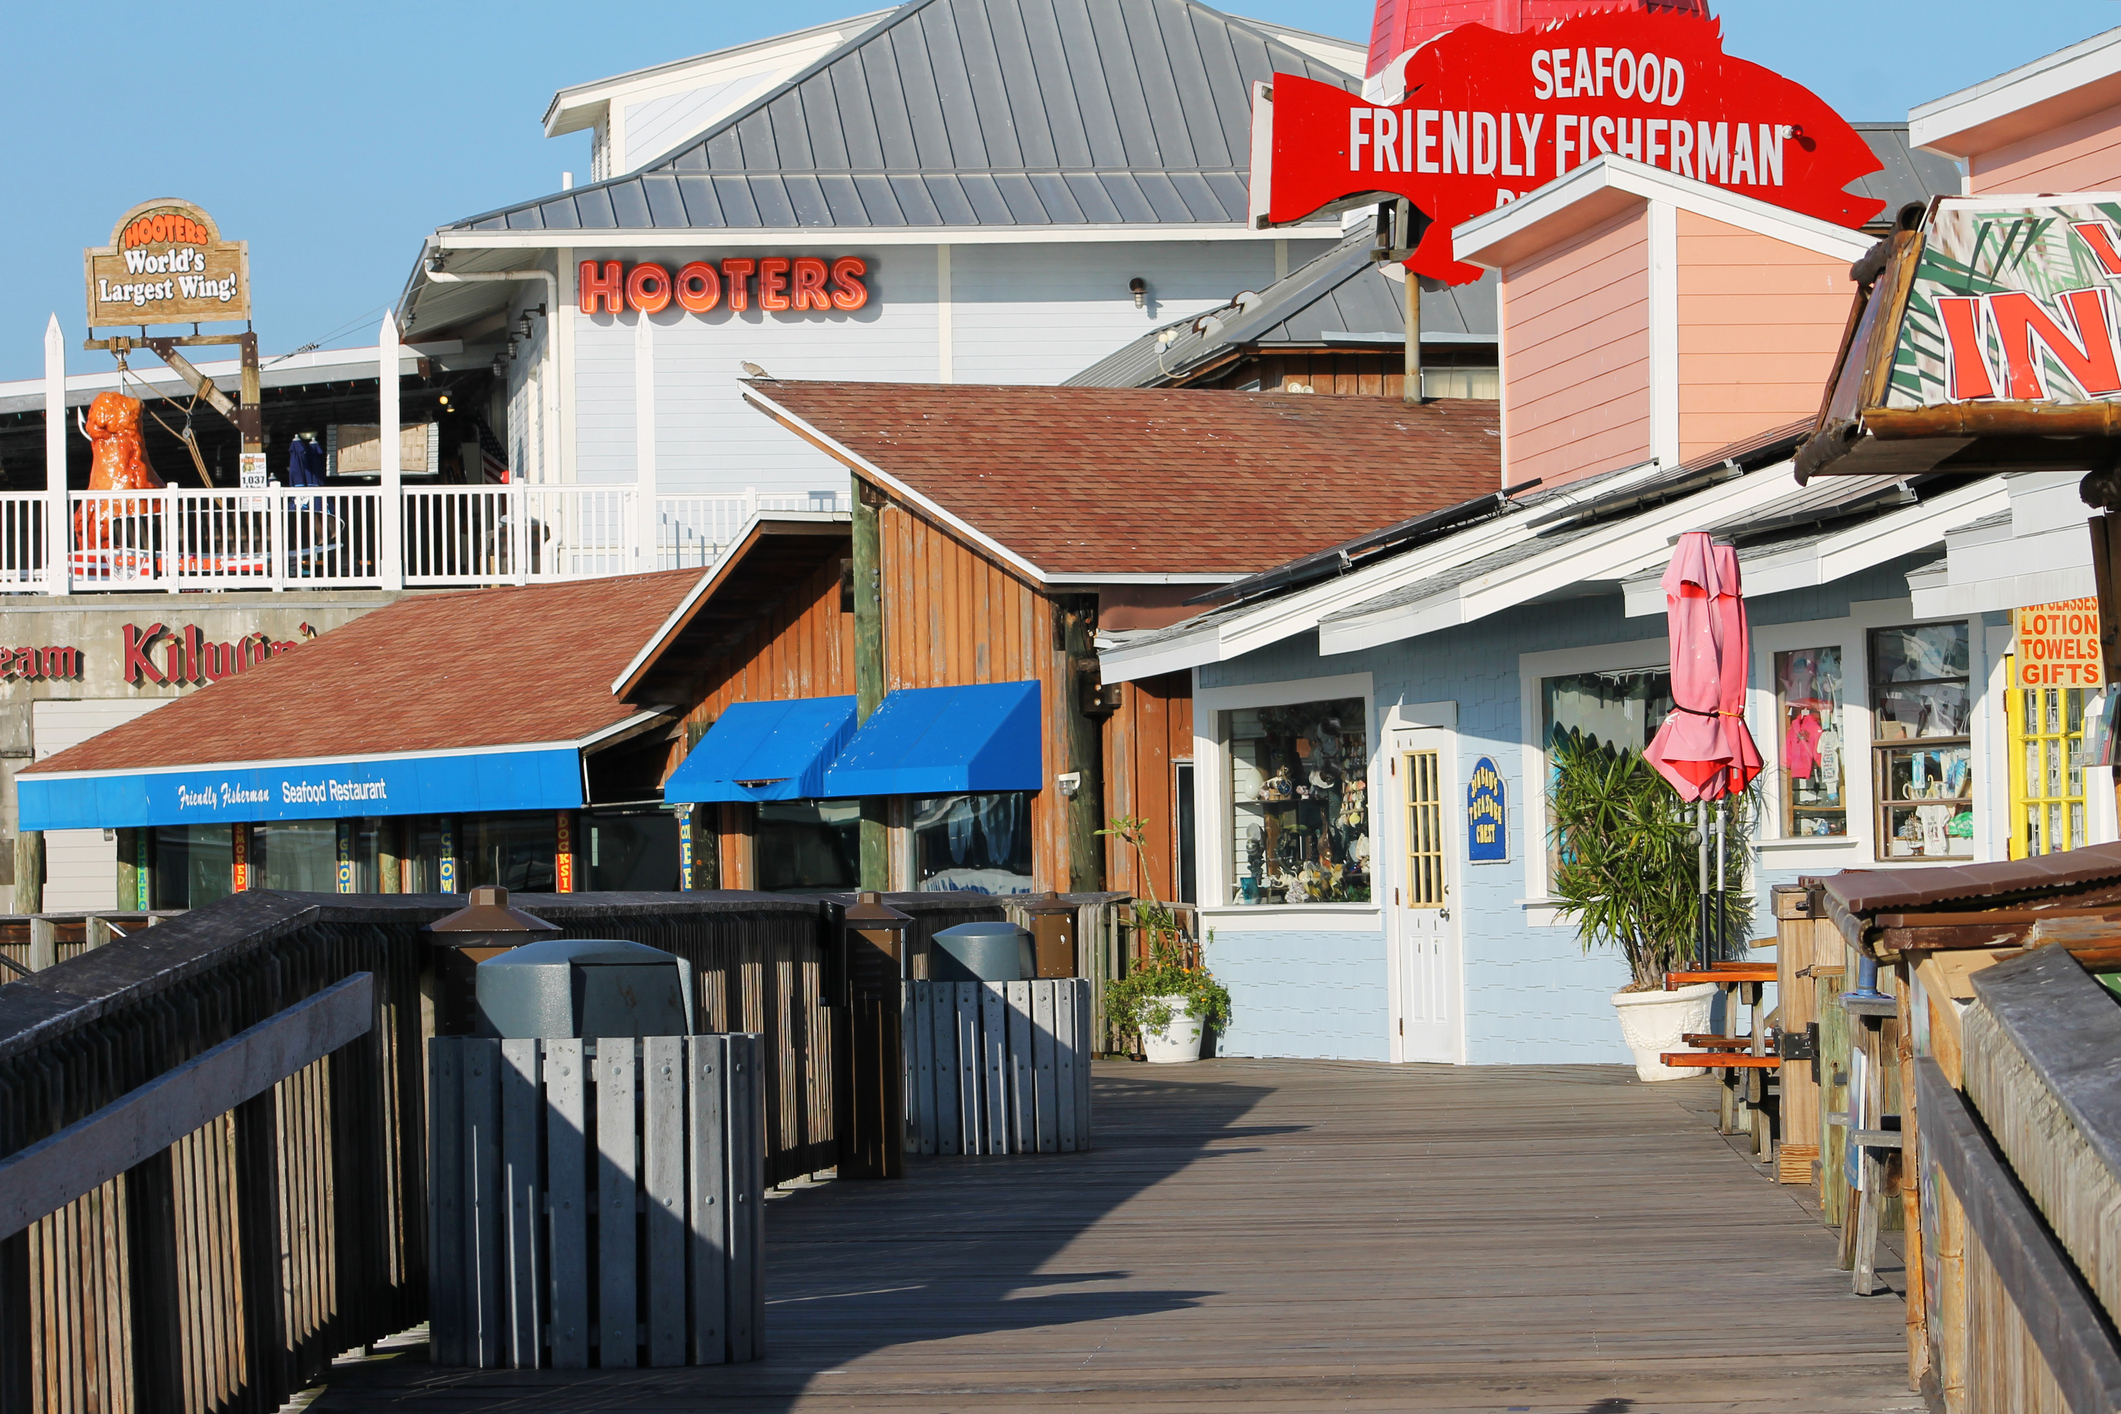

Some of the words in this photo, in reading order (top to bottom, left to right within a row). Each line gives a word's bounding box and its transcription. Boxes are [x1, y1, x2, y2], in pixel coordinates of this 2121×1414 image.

[1531, 47, 1685, 107] SEAFOOD
[1349, 107, 1544, 177] FRIENDLY
[1555, 114, 1784, 186] FISHERMAN
[125, 214, 209, 249] HOOTERS
[124, 248, 206, 275] World's
[99, 279, 174, 306] Largest
[178, 272, 237, 302] Wing!
[578, 256, 868, 314] HOOTERS
[2021, 614, 2098, 635] LOTION
[2020, 638, 2099, 660] TOWELS
[2022, 663, 2099, 684] GIFTS
[178, 785, 218, 810] Friendly
[220, 782, 270, 808] Fisherman
[282, 780, 327, 804] Seafood
[328, 778, 387, 801] Restaurant
[1469, 794, 1502, 826] TREASURE
[1476, 824, 1496, 844] CHEST
[236, 823, 245, 886] SMOKED
[558, 817, 570, 893] DOCKSI
